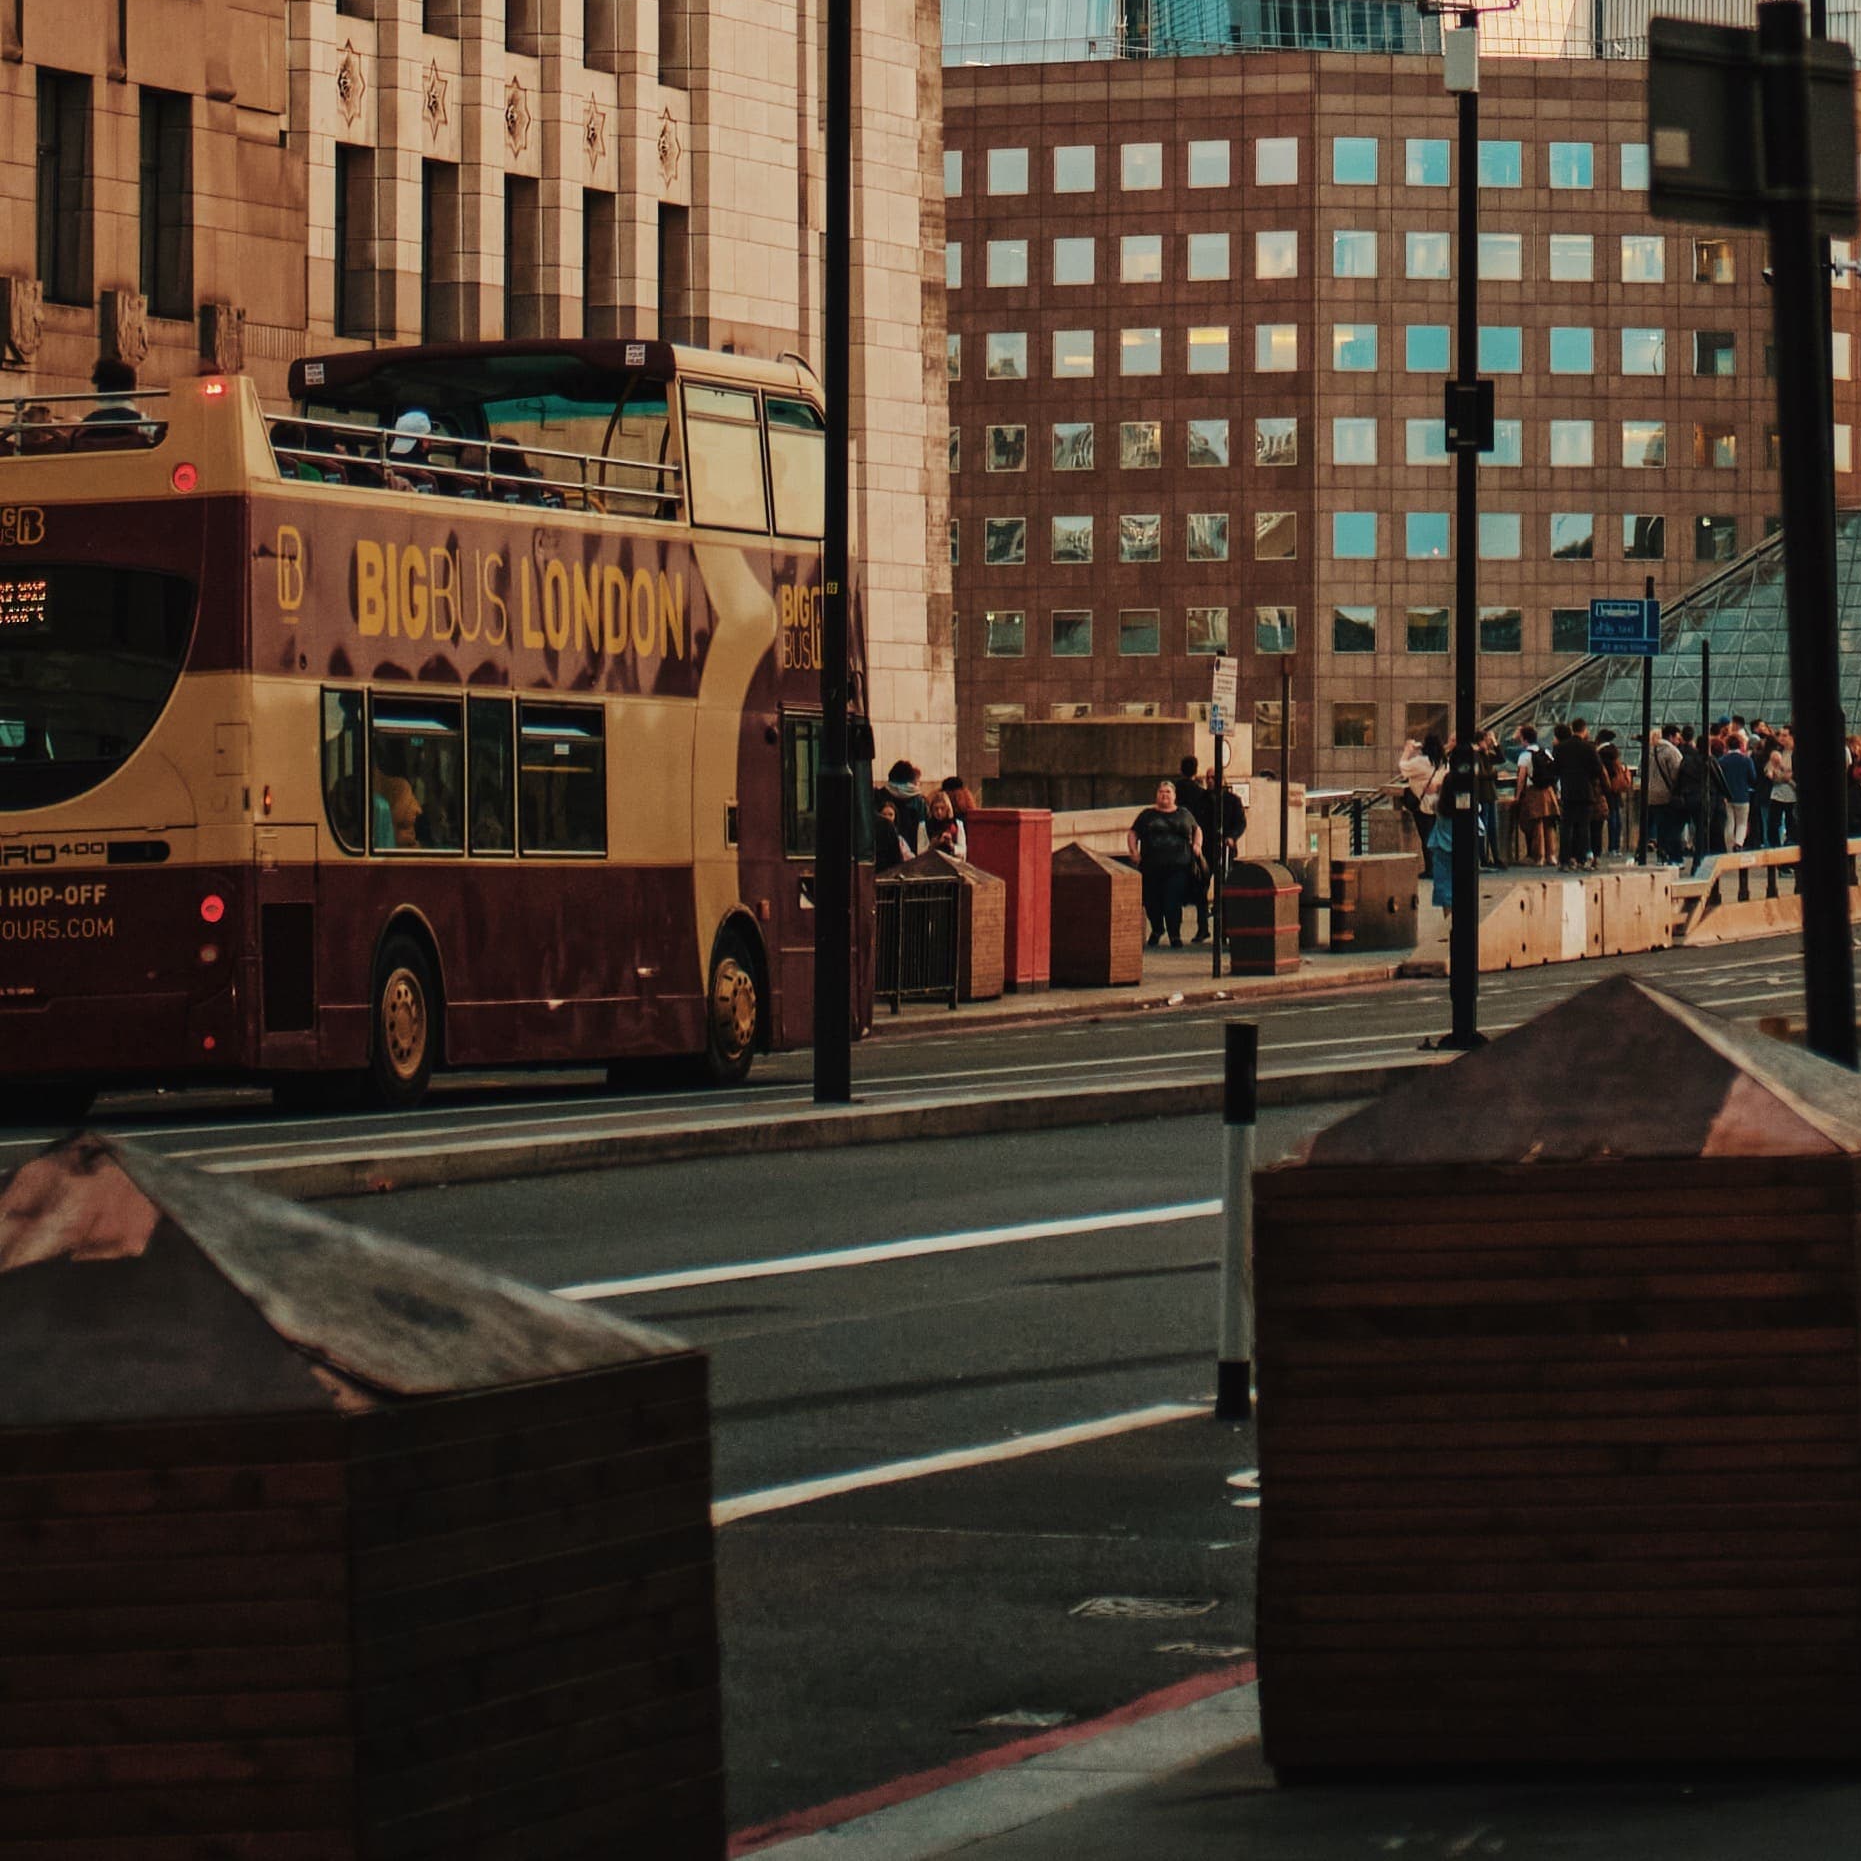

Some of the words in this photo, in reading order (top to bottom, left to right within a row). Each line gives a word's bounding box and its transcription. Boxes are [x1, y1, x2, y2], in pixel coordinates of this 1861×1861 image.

[520, 554, 684, 661] LONDON
[781, 584, 810, 628] BIG
[783, 630, 811, 670] BUS
[9, 884, 108, 907] HOP-OFF
[0, 917, 115, 941] OURS.COM
